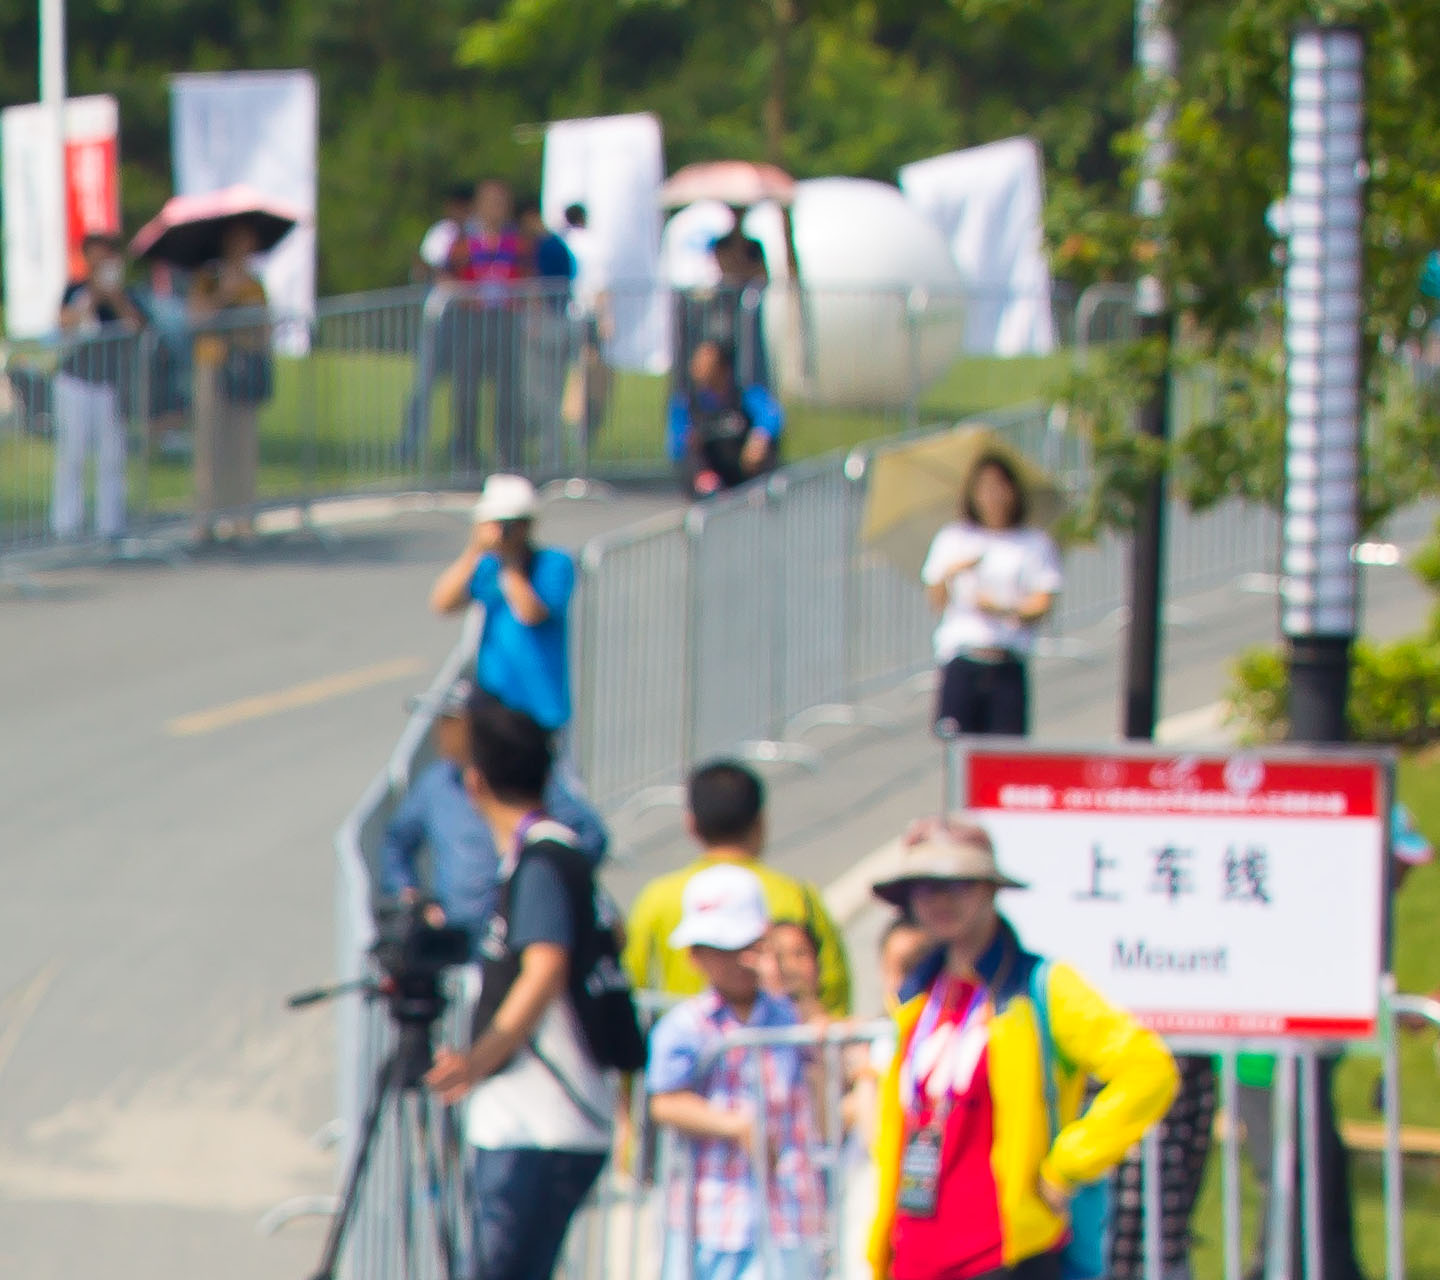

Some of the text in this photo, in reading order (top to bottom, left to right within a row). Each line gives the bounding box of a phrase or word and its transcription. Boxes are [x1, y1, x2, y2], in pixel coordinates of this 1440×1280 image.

[1075, 840, 1270, 905] 上车线
[1112, 938, 1228, 972] Mount
